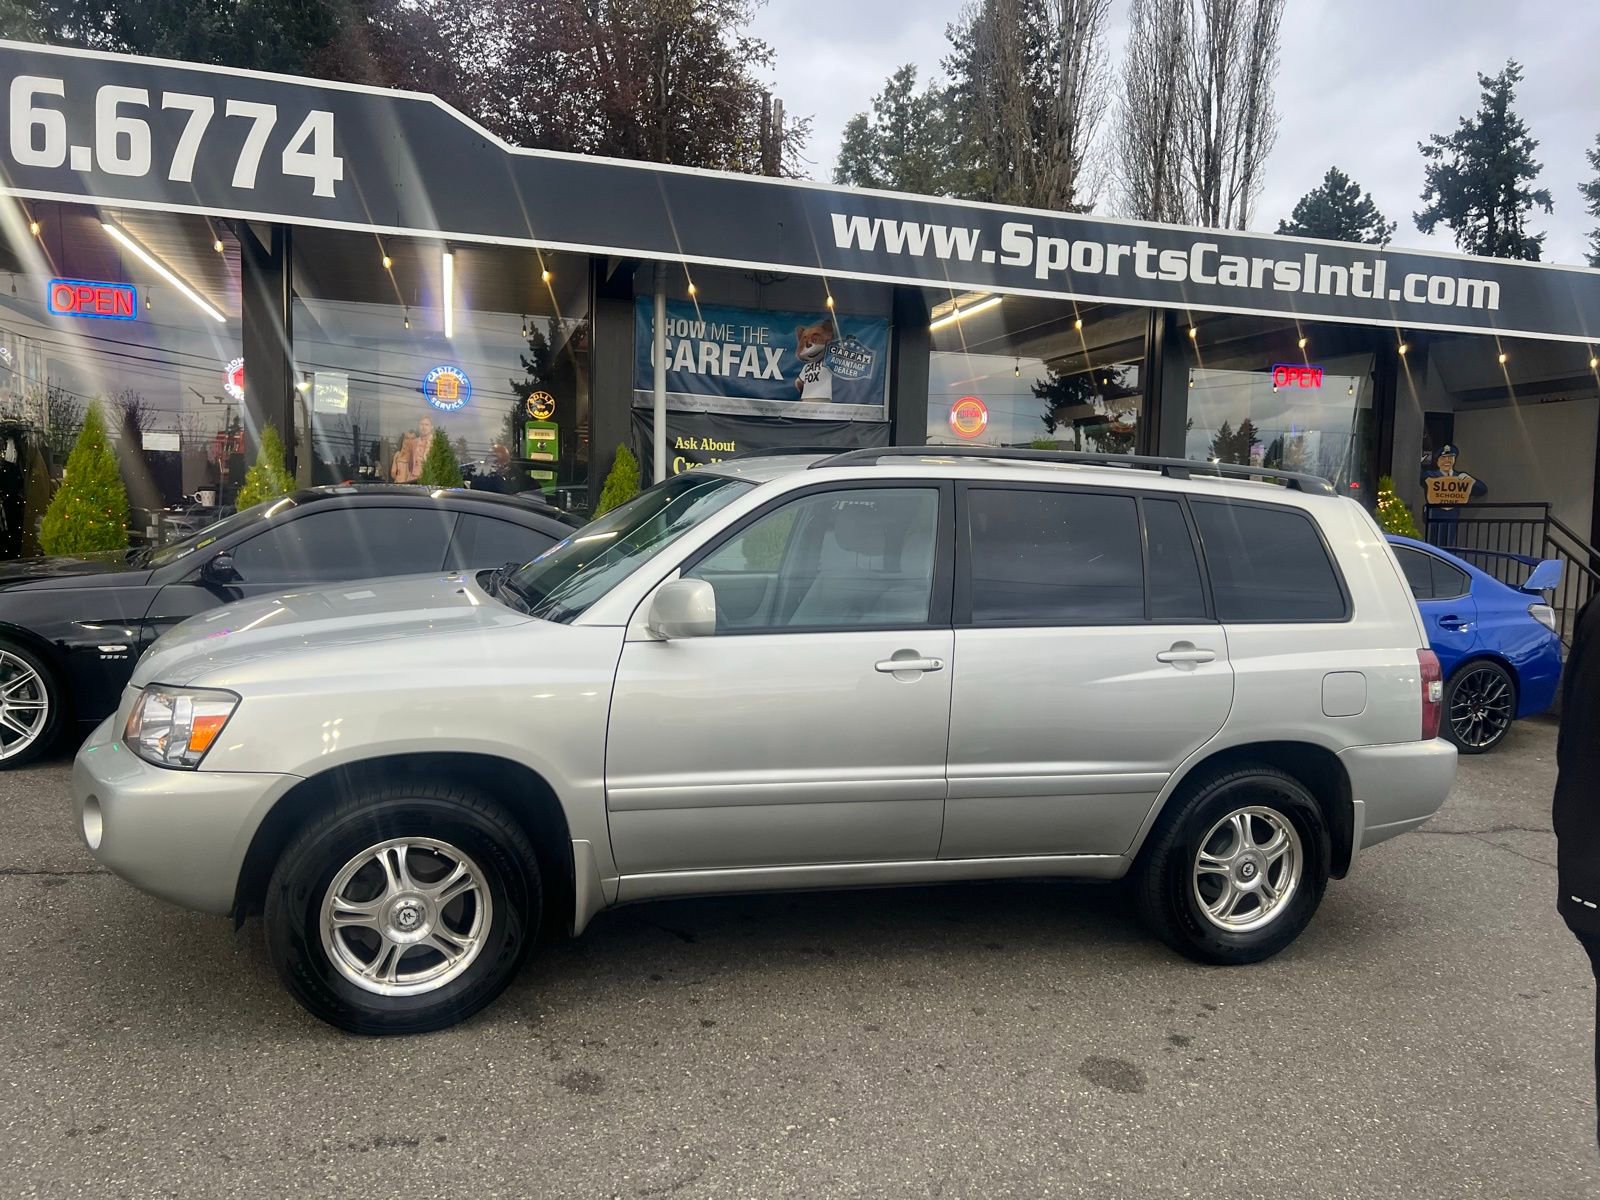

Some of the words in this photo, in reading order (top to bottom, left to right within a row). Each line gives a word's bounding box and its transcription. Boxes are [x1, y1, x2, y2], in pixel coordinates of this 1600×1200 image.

[9, 75, 344, 198] 6.6774
[830, 213, 1500, 310] www.SportsCarsIntl.com
[53, 284, 132, 316] OPEN
[711, 323, 735, 342] ME
[740, 325, 769, 345] THE
[830, 347, 871, 363] CARFAX
[830, 356, 866, 372] ADVANTAGE
[833, 365, 858, 377] DEALER
[428, 366, 468, 385] CADILLAC
[804, 372, 820, 383] FOX
[1274, 367, 1322, 388] OPEN
[431, 397, 463, 410] SERVICE
[675, 436, 698, 450] Ask
[700, 438, 736, 452] About
[1433, 481, 1469, 493] SLOW
